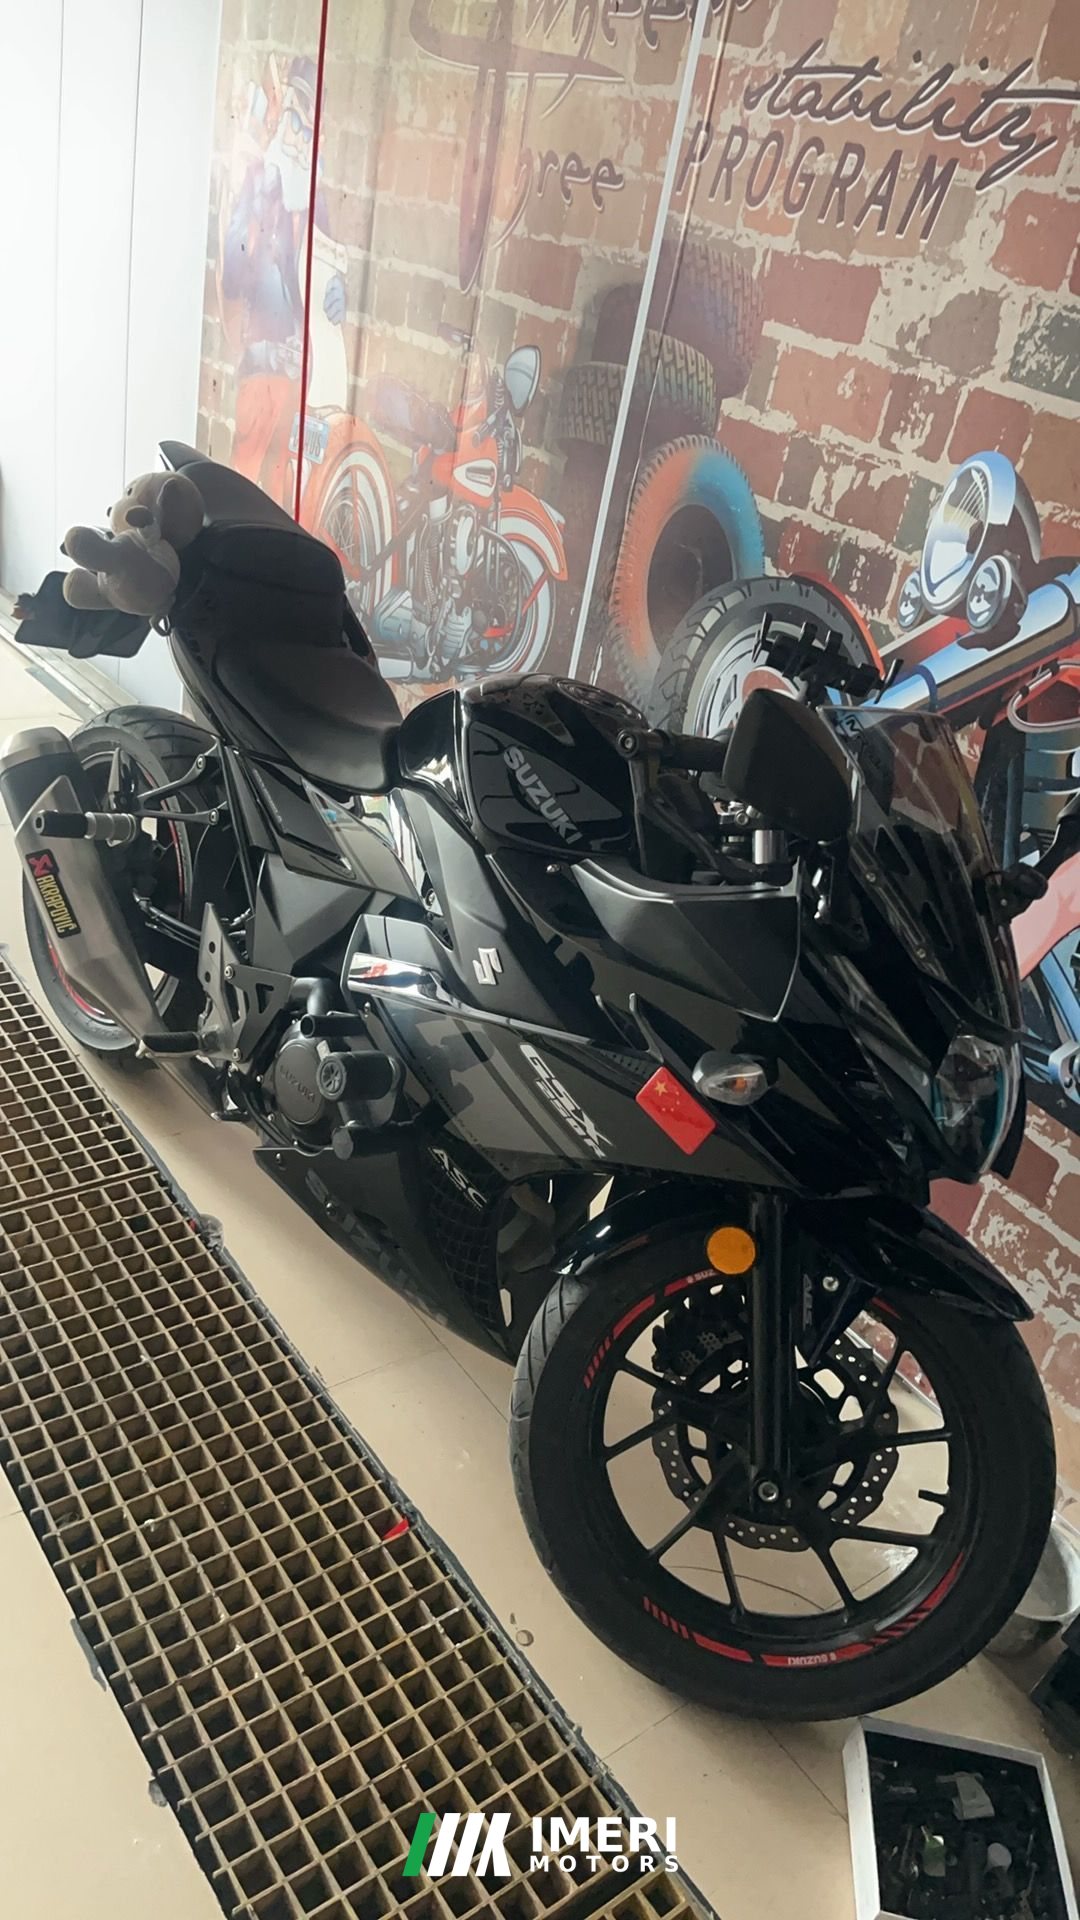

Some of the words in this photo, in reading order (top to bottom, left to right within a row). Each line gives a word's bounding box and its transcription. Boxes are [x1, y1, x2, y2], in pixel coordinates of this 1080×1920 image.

[742, 38, 1080, 194] stability
[675, 119, 960, 243] PROGRAM
[503, 746, 583, 844] SUZUKI
[787, 1653, 829, 1666] SUZUKI
